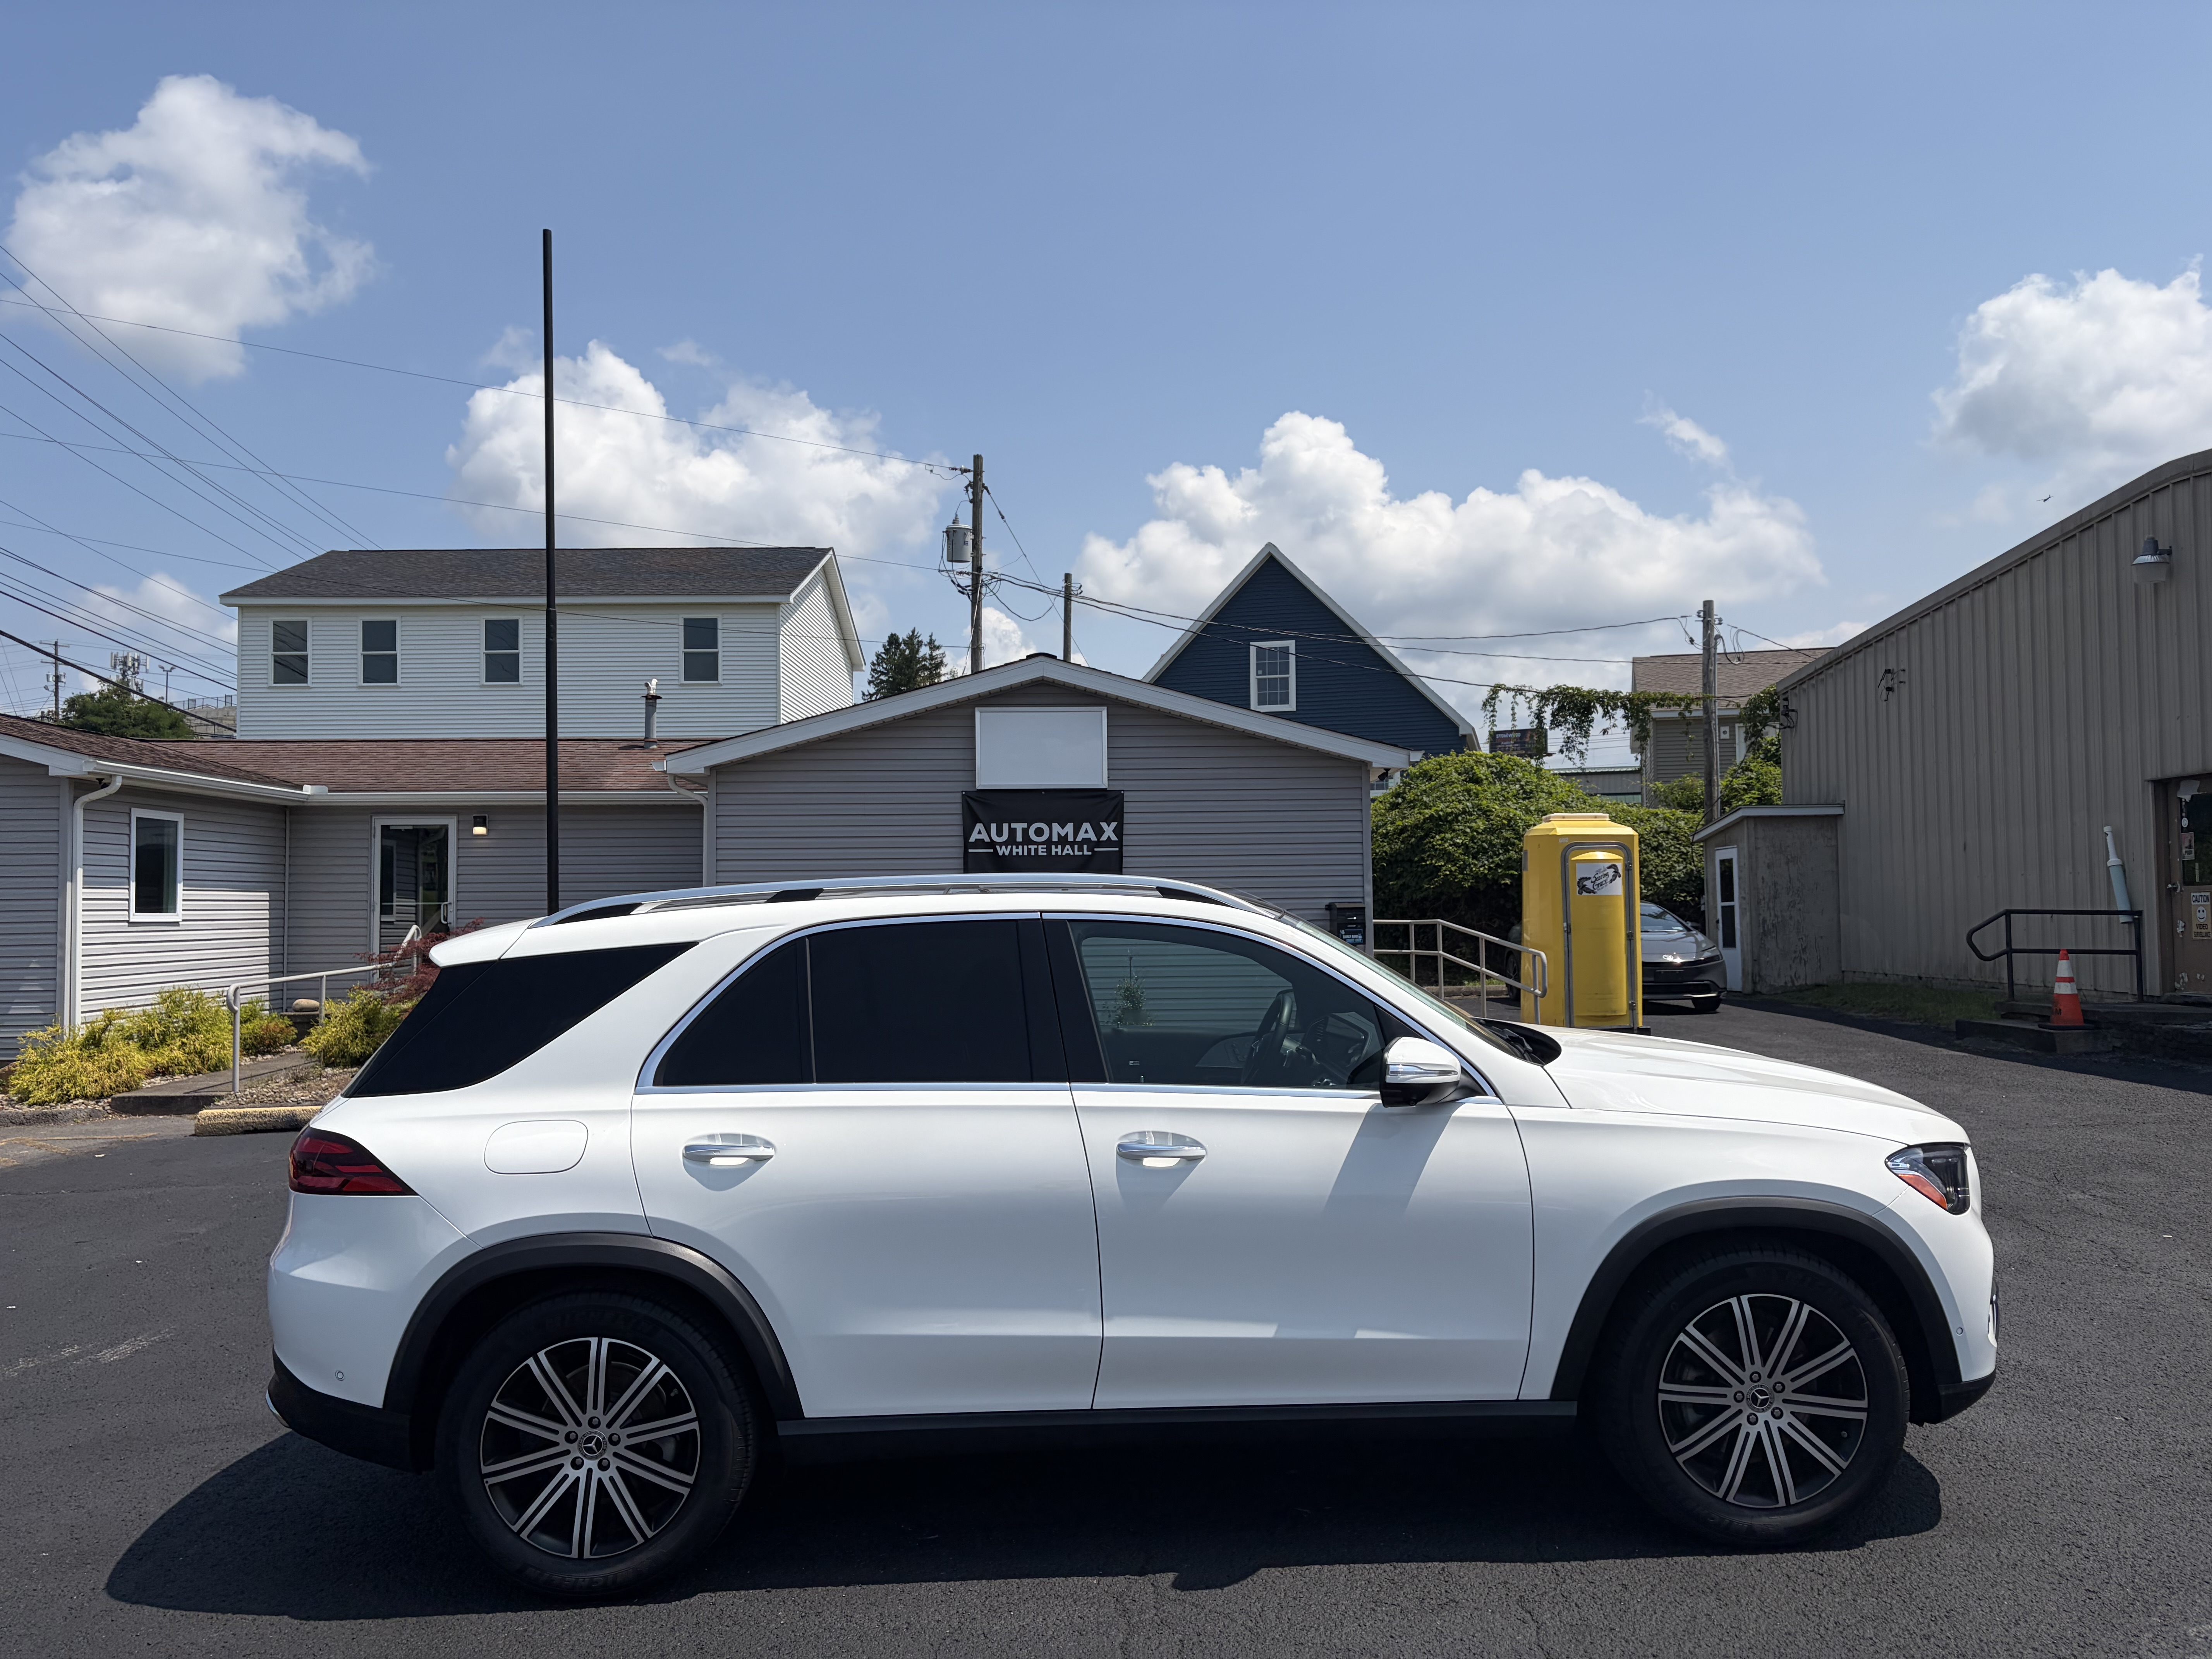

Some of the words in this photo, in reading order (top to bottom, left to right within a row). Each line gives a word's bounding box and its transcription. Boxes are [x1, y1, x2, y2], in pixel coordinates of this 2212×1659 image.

[969, 822, 1118, 842] AUTOMAX
[996, 845, 1046, 856] WHITE
[1052, 845, 1092, 855] HALL
[2192, 895, 2210, 903] CAUTION
